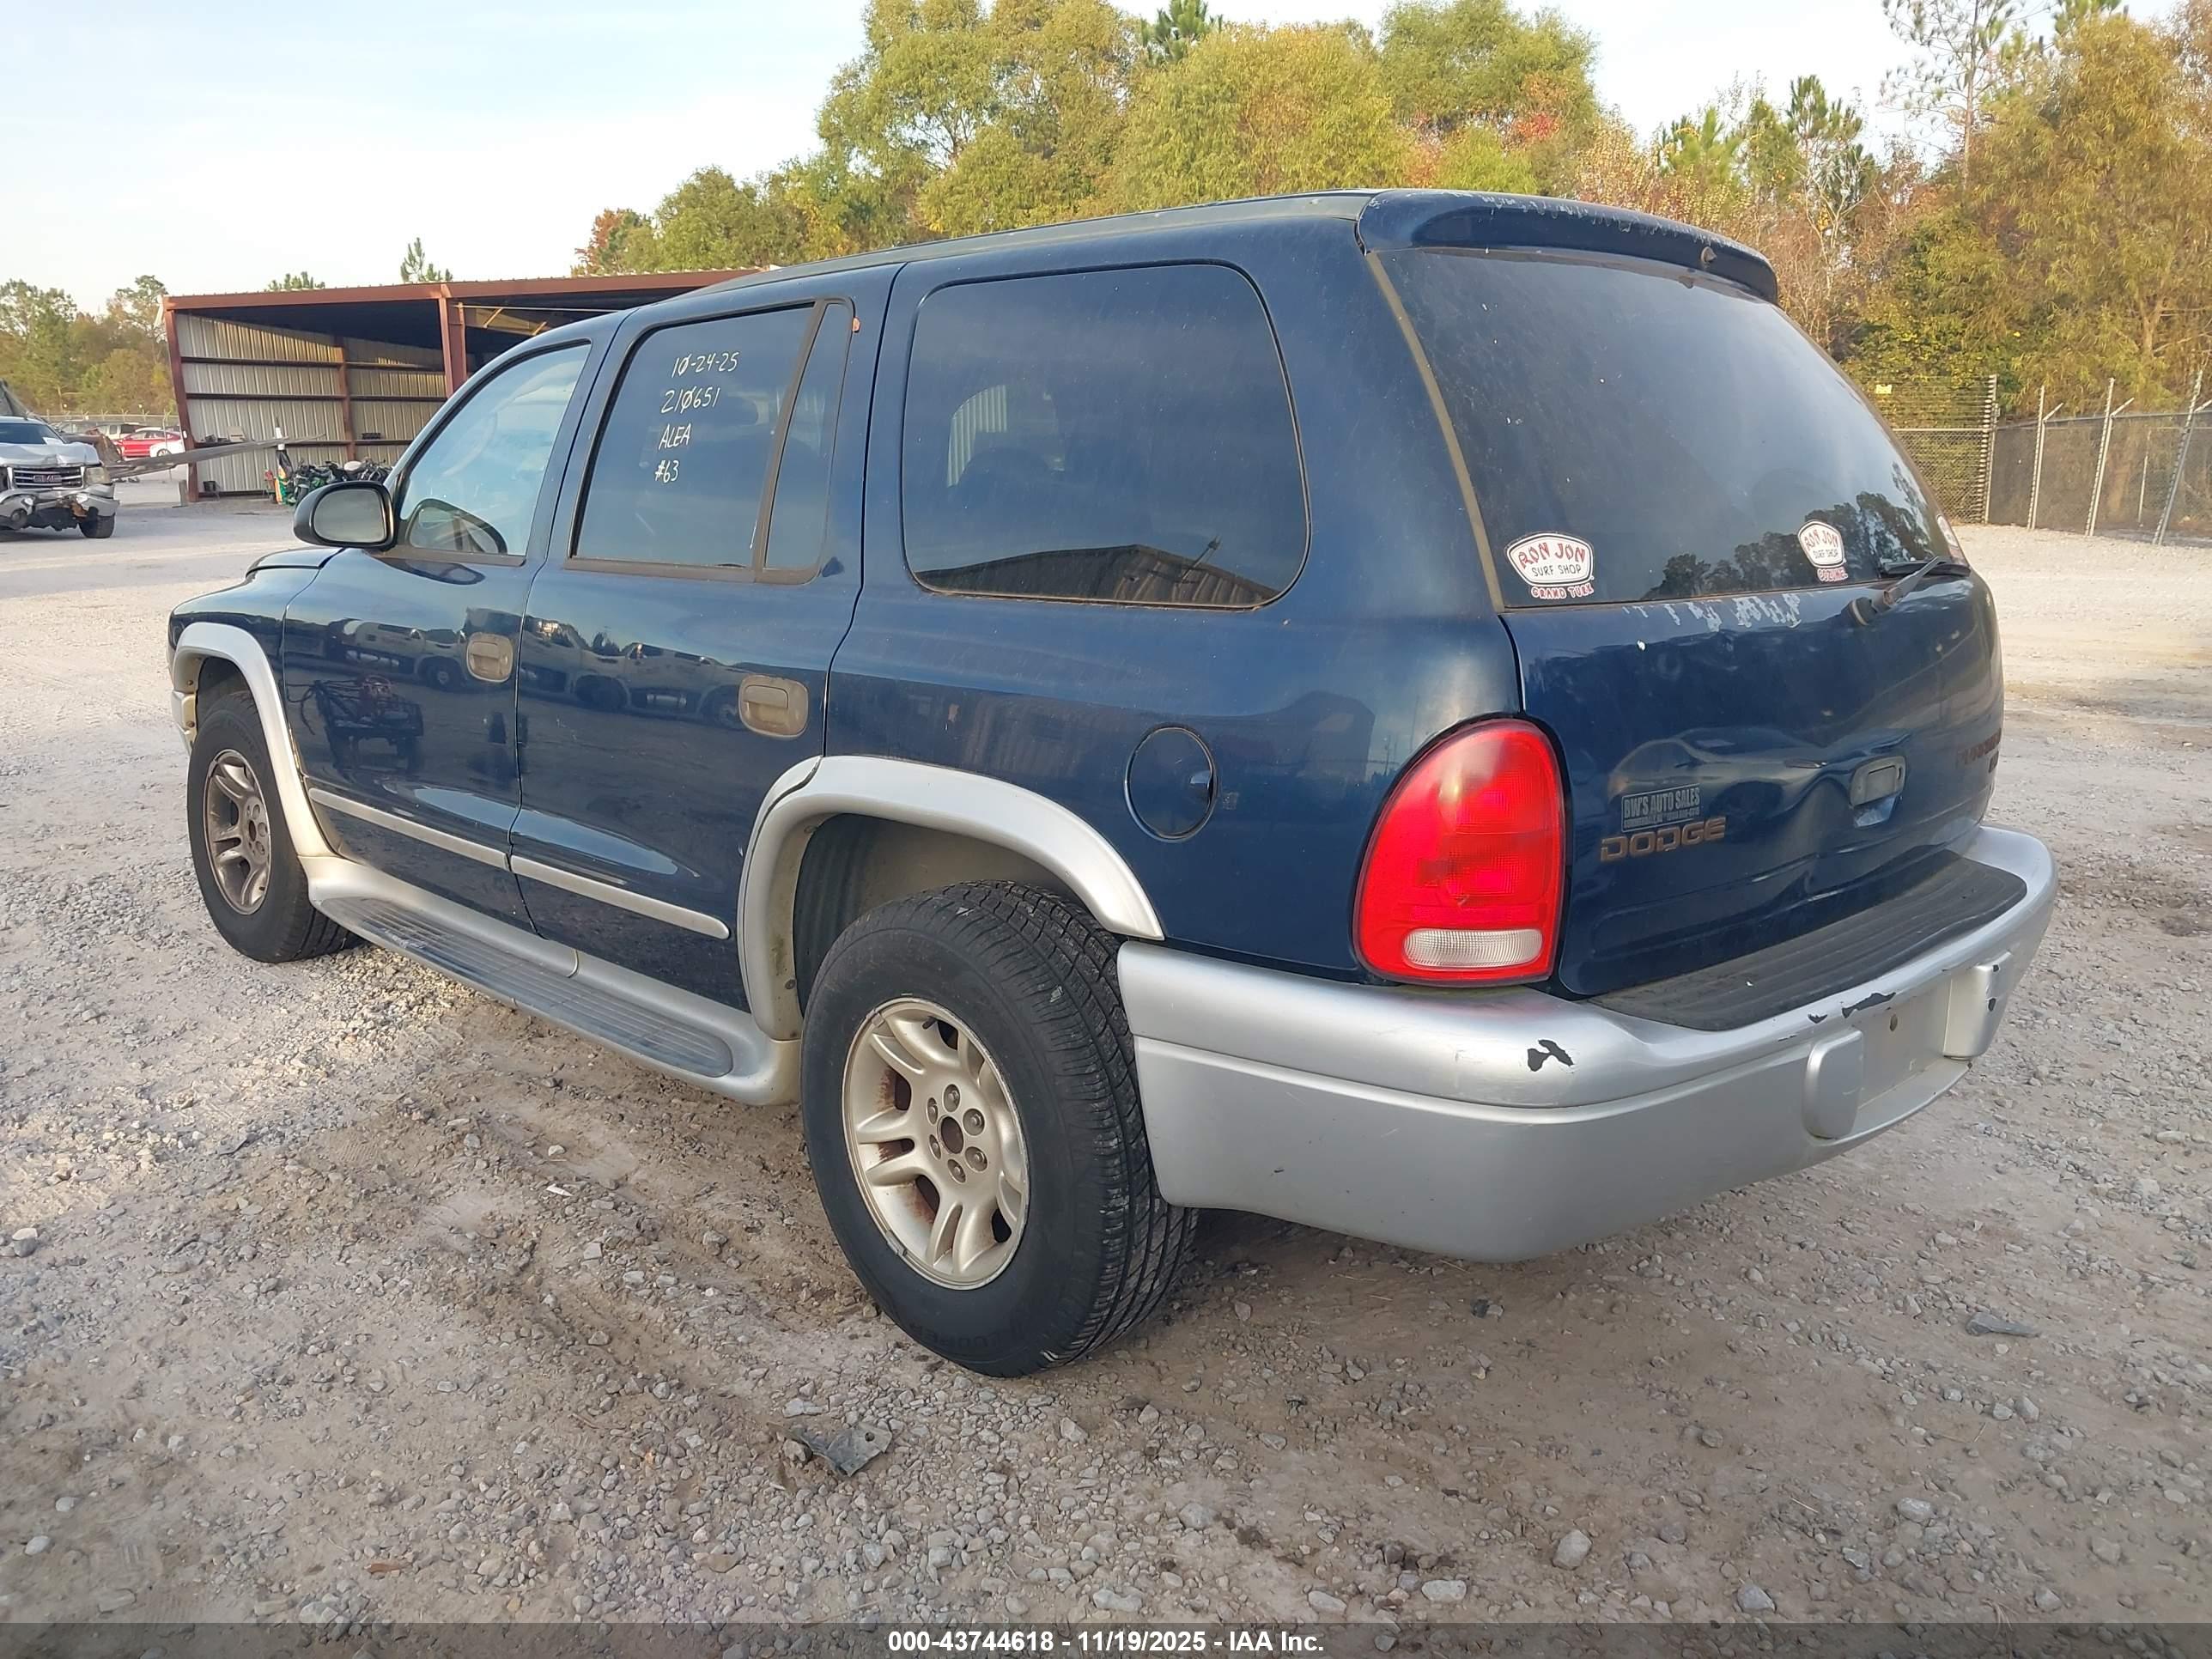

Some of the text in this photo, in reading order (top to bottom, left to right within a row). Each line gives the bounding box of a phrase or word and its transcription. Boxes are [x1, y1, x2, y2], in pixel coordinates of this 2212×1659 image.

[671, 352, 739, 378] 10-24-25
[660, 386, 720, 414] 210651
[658, 422, 692, 451] ALEA
[654, 459, 679, 483] #63
[1804, 529, 1838, 551] RON JON
[1517, 542, 1586, 568] RON JON
[1531, 563, 1582, 577] SURF SHOP
[1531, 583, 1594, 599] GRAND TURK
[1650, 792, 1674, 814] AUTO
[1675, 787, 1700, 810] SALES
[1600, 817, 1726, 862] DODGE
